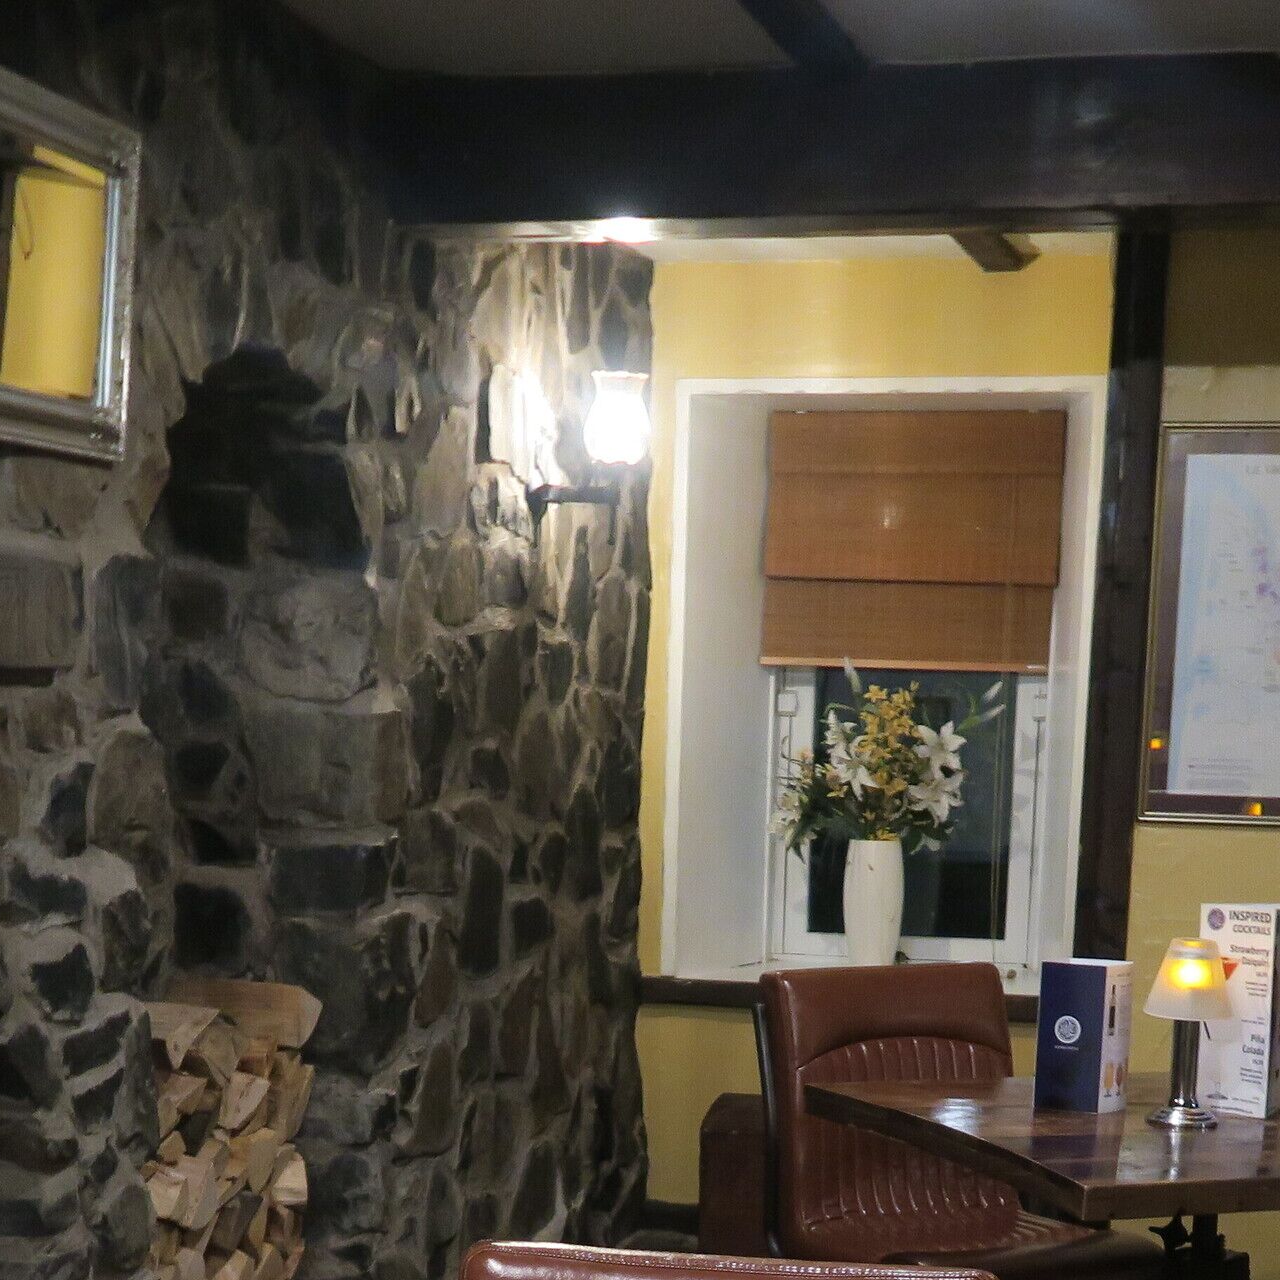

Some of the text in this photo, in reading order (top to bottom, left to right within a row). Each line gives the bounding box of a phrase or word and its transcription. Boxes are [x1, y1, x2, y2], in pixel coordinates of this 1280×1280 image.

[1229, 910, 1271, 923] INSPIRED
[1232, 924, 1271, 936] COCKTAILS
[1229, 944, 1270, 957] Strawberry
